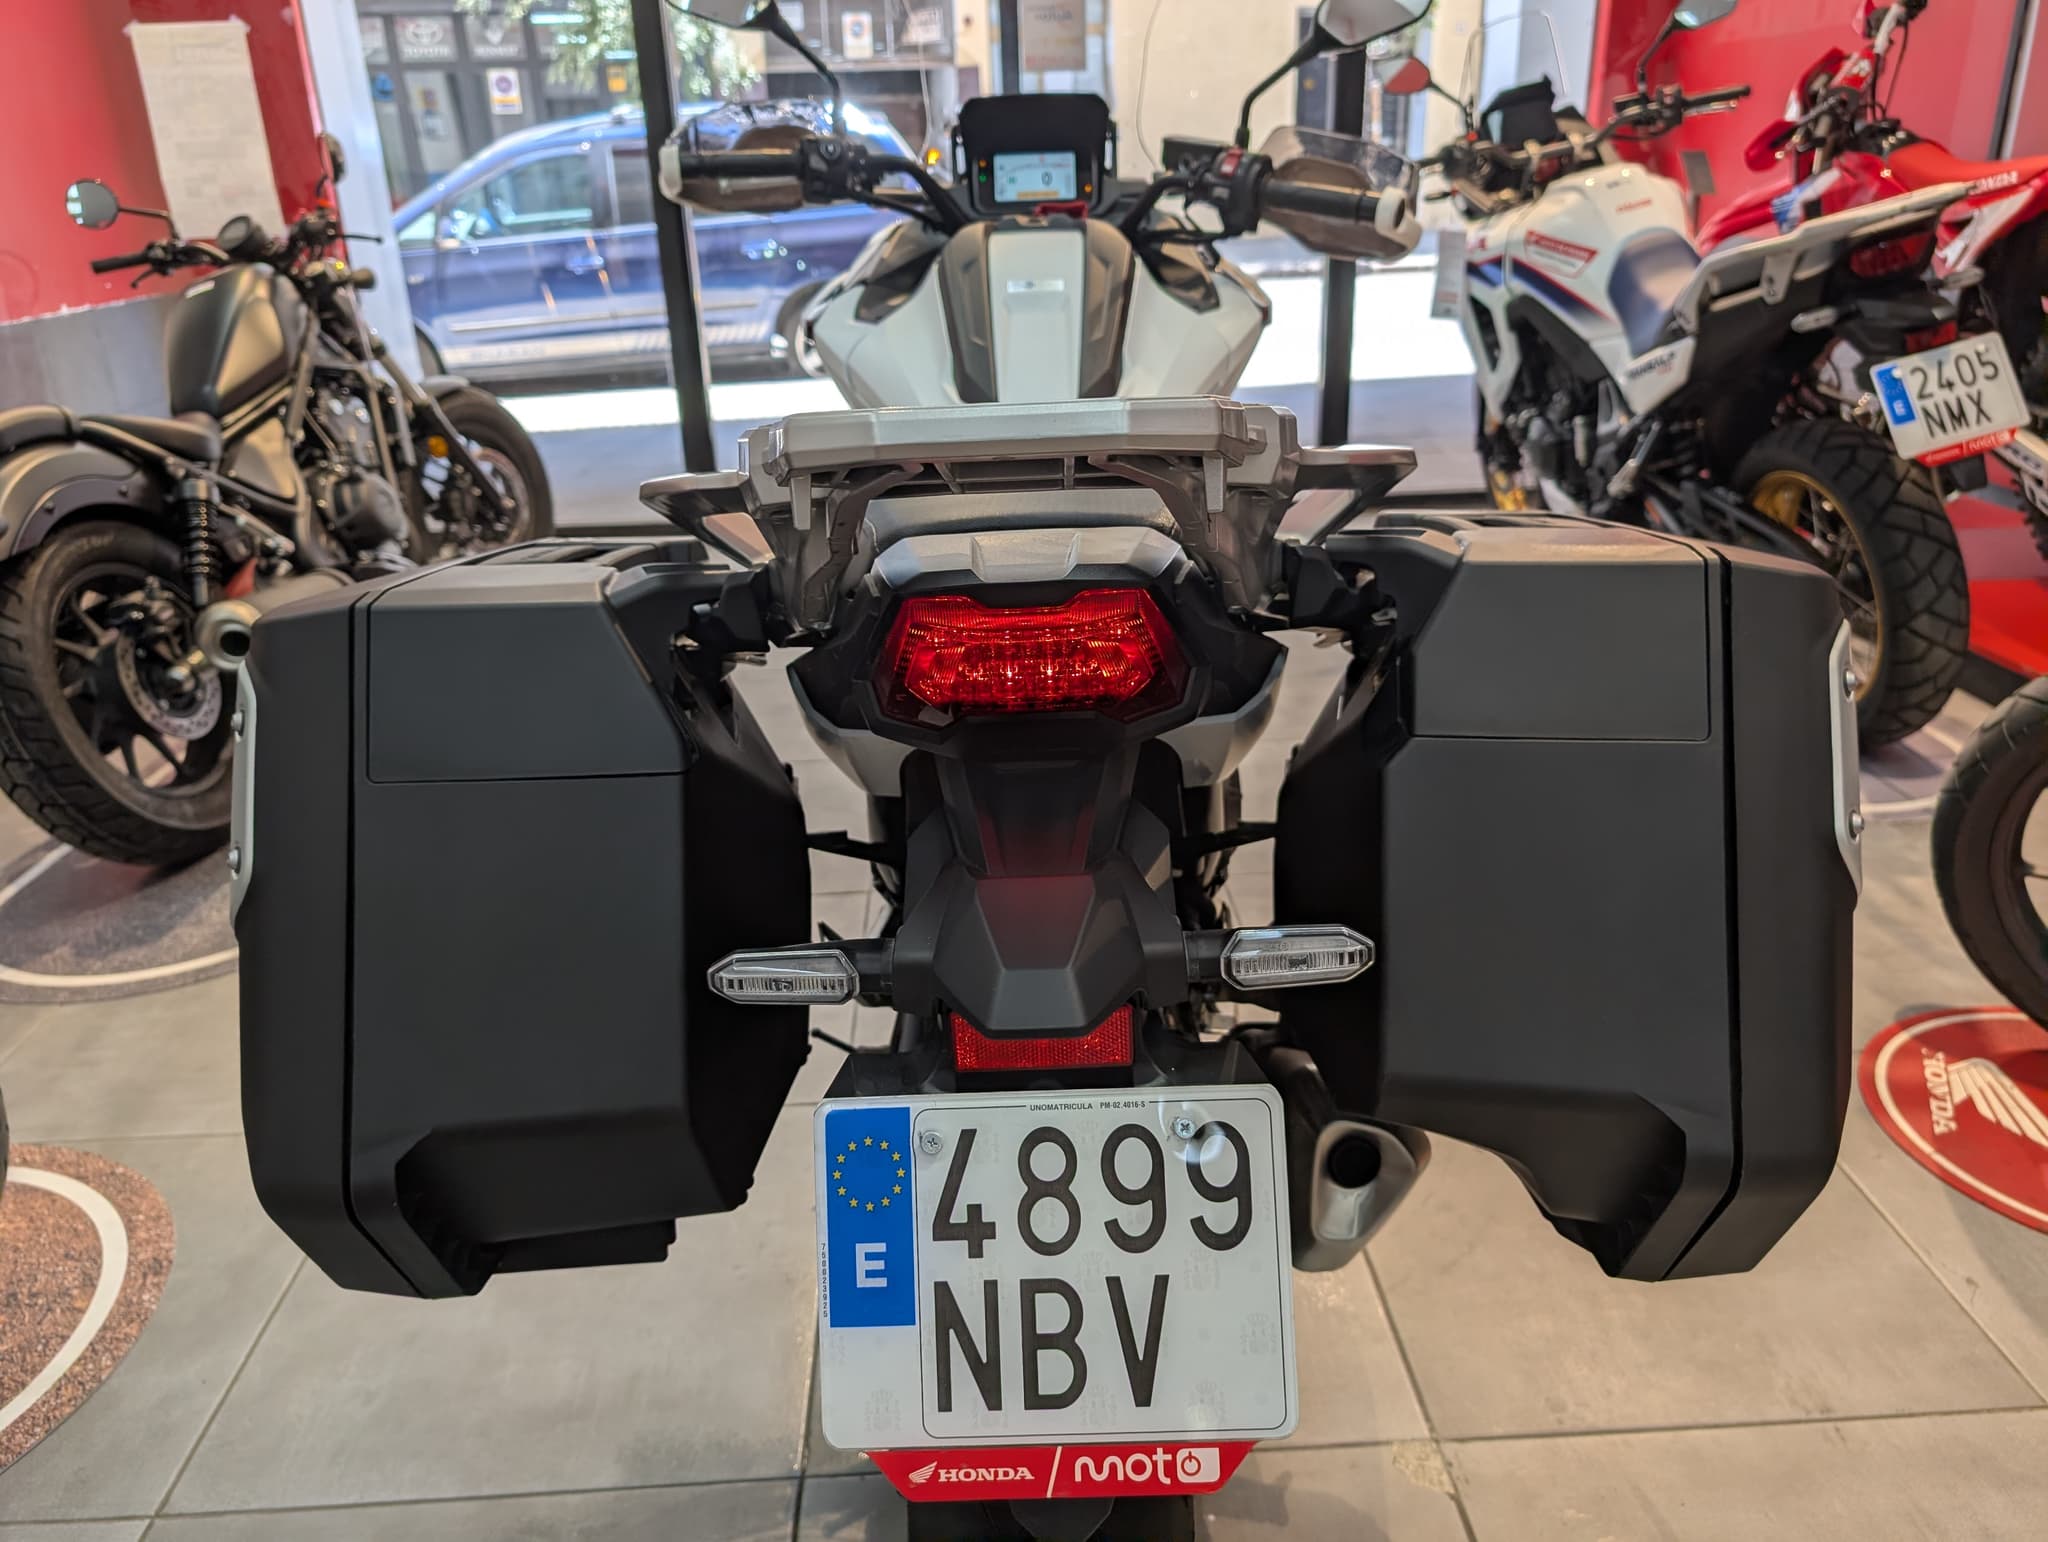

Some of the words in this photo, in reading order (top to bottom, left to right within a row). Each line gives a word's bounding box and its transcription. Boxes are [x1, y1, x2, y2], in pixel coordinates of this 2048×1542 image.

[1910, 346, 1999, 399] 2405
[1921, 389, 1992, 438] NMX
[1029, 1103, 1093, 1111] UNOMATRICULA
[932, 1120, 1253, 1258] 4899
[855, 1242, 887, 1288] E
[933, 1274, 1170, 1413] NBV
[938, 1467, 1035, 1482] HONDA
